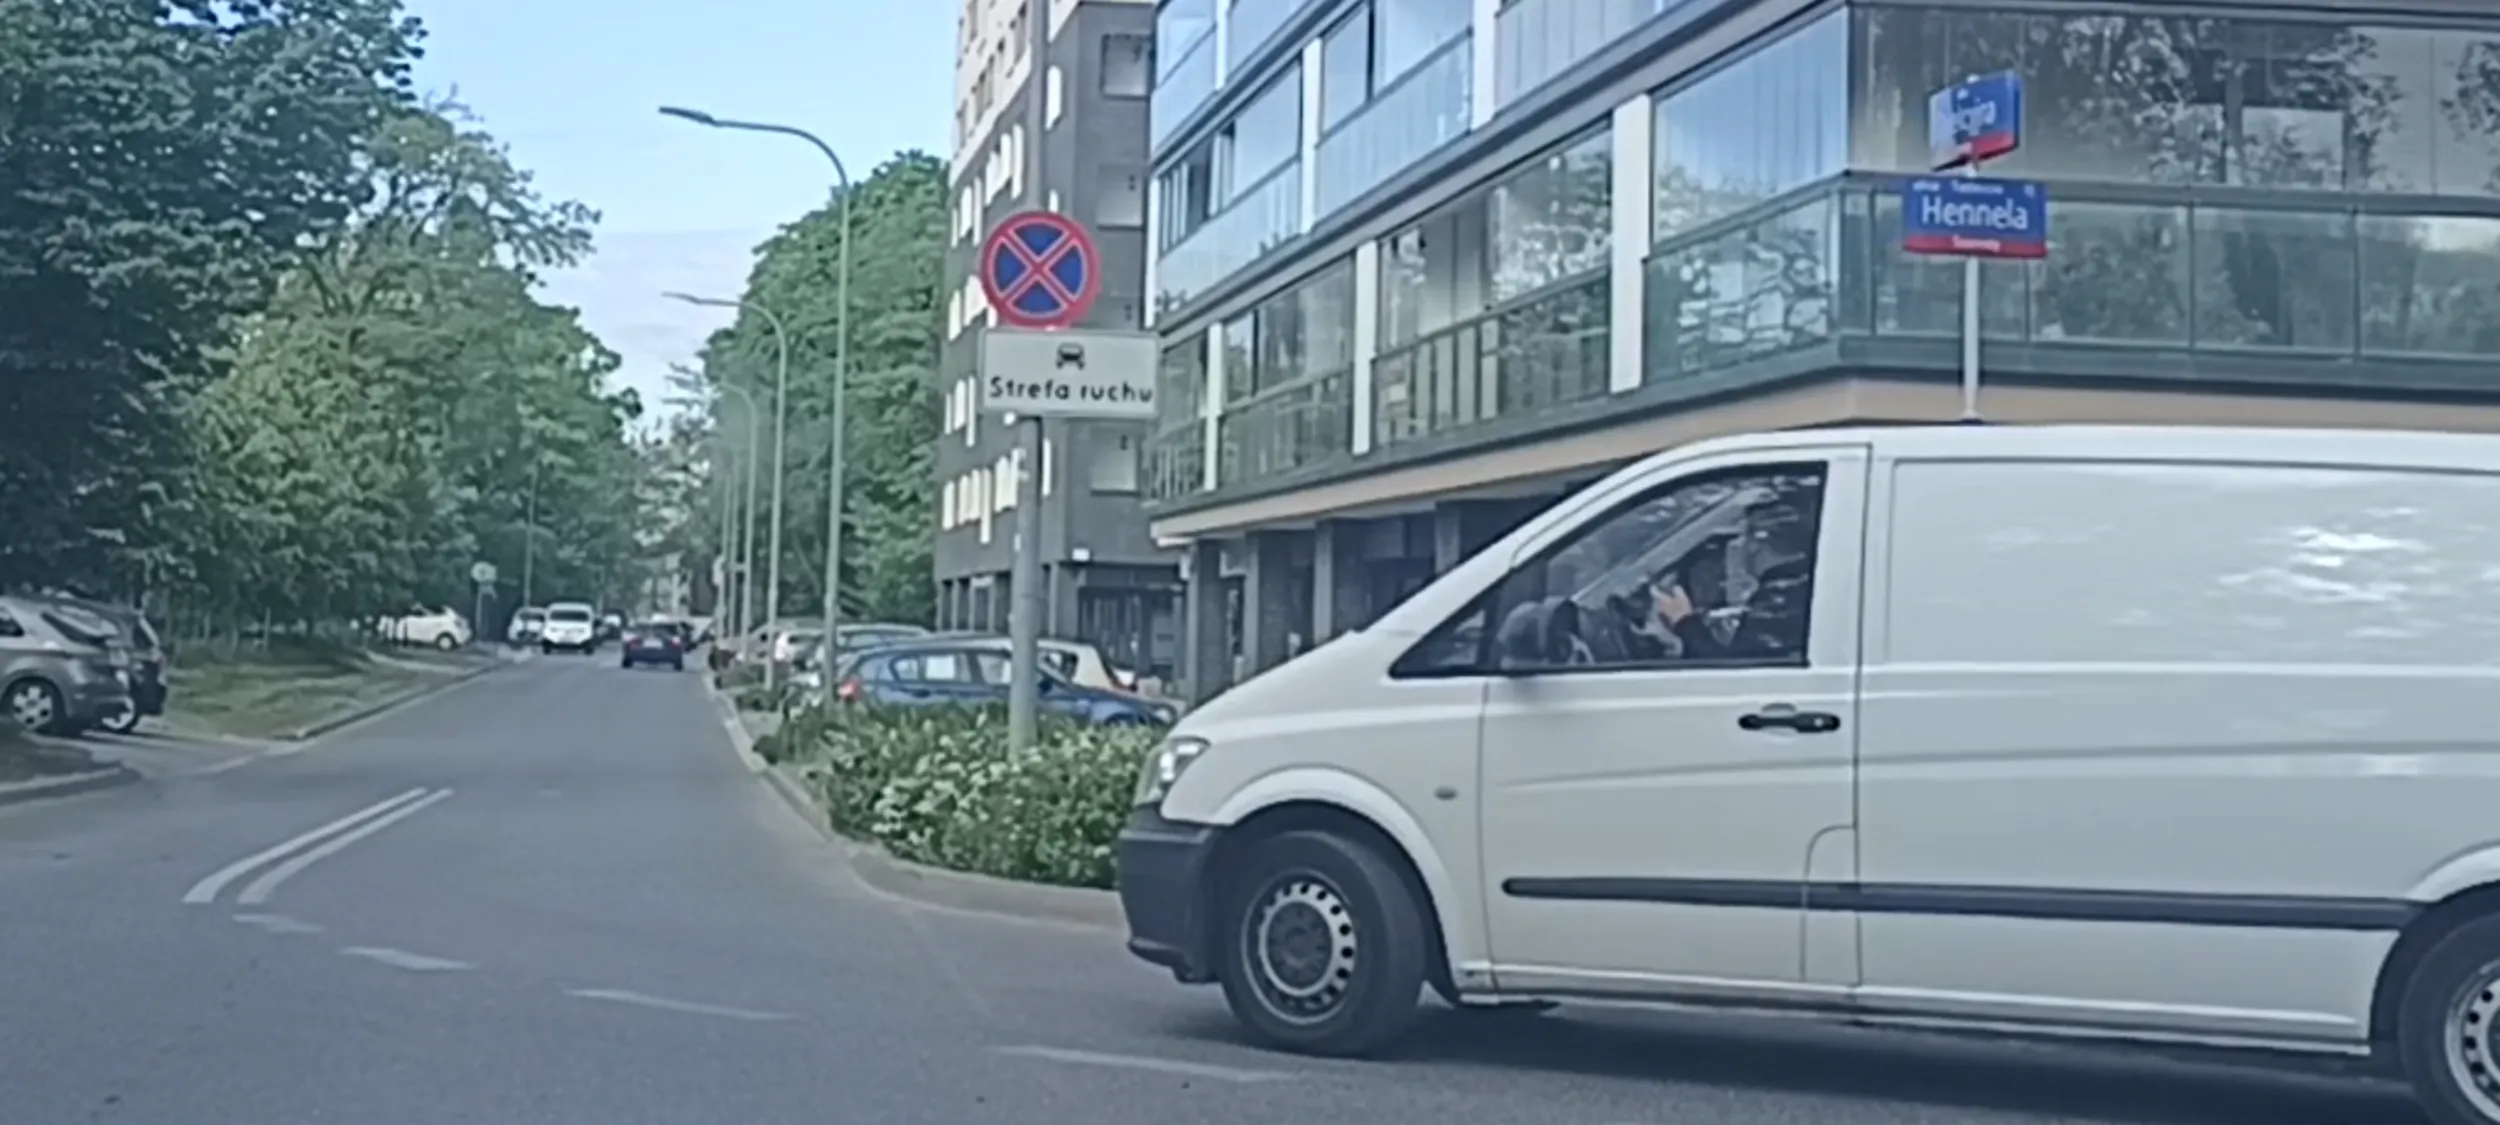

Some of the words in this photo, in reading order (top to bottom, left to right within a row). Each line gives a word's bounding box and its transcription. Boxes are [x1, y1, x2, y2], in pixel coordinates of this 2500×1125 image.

[1921, 195, 2028, 230] Hennela
[989, 376, 1070, 401] Strefa
[1080, 381, 1153, 402] ruchu
